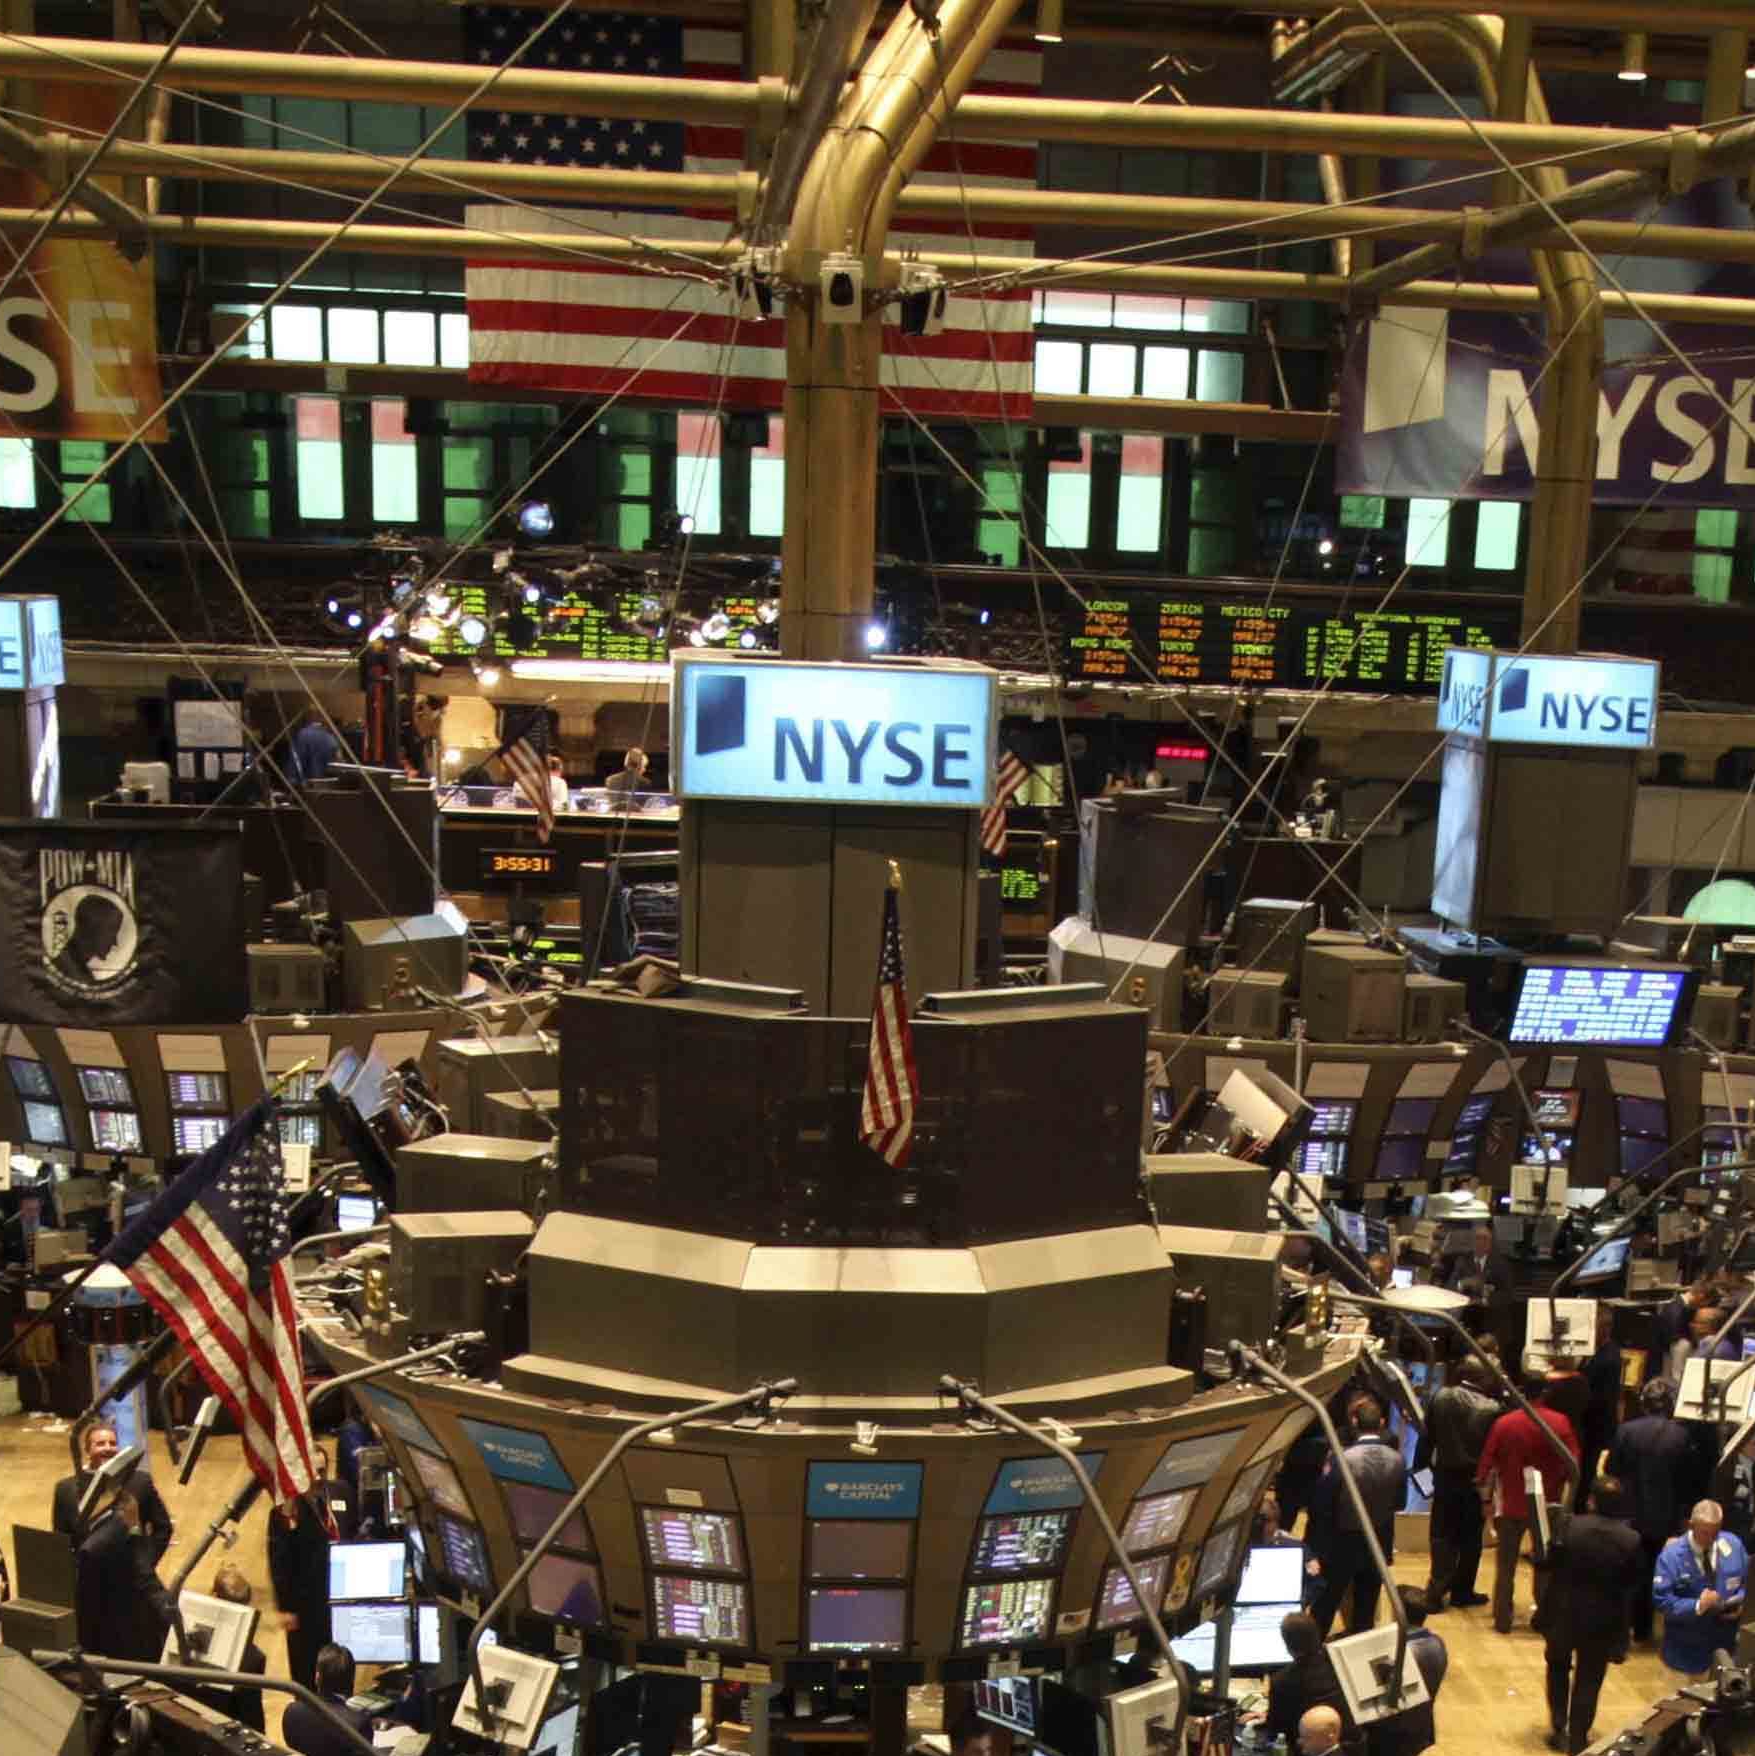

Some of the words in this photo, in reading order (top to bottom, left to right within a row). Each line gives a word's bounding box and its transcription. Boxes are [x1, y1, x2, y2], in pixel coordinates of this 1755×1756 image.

[1221, 606, 1263, 617] MEXICO
[1267, 607, 1291, 619] CTY
[1160, 641, 1194, 653] TOKYO
[1450, 682, 1485, 730] NYSE
[1539, 691, 1652, 736] NYSE
[773, 717, 973, 789] NYSE
[39, 849, 84, 908] POW
[97, 851, 136, 909] MIA
[492, 854, 551, 875] 3:55:31
[840, 1482, 904, 1492] BARCLAYS
